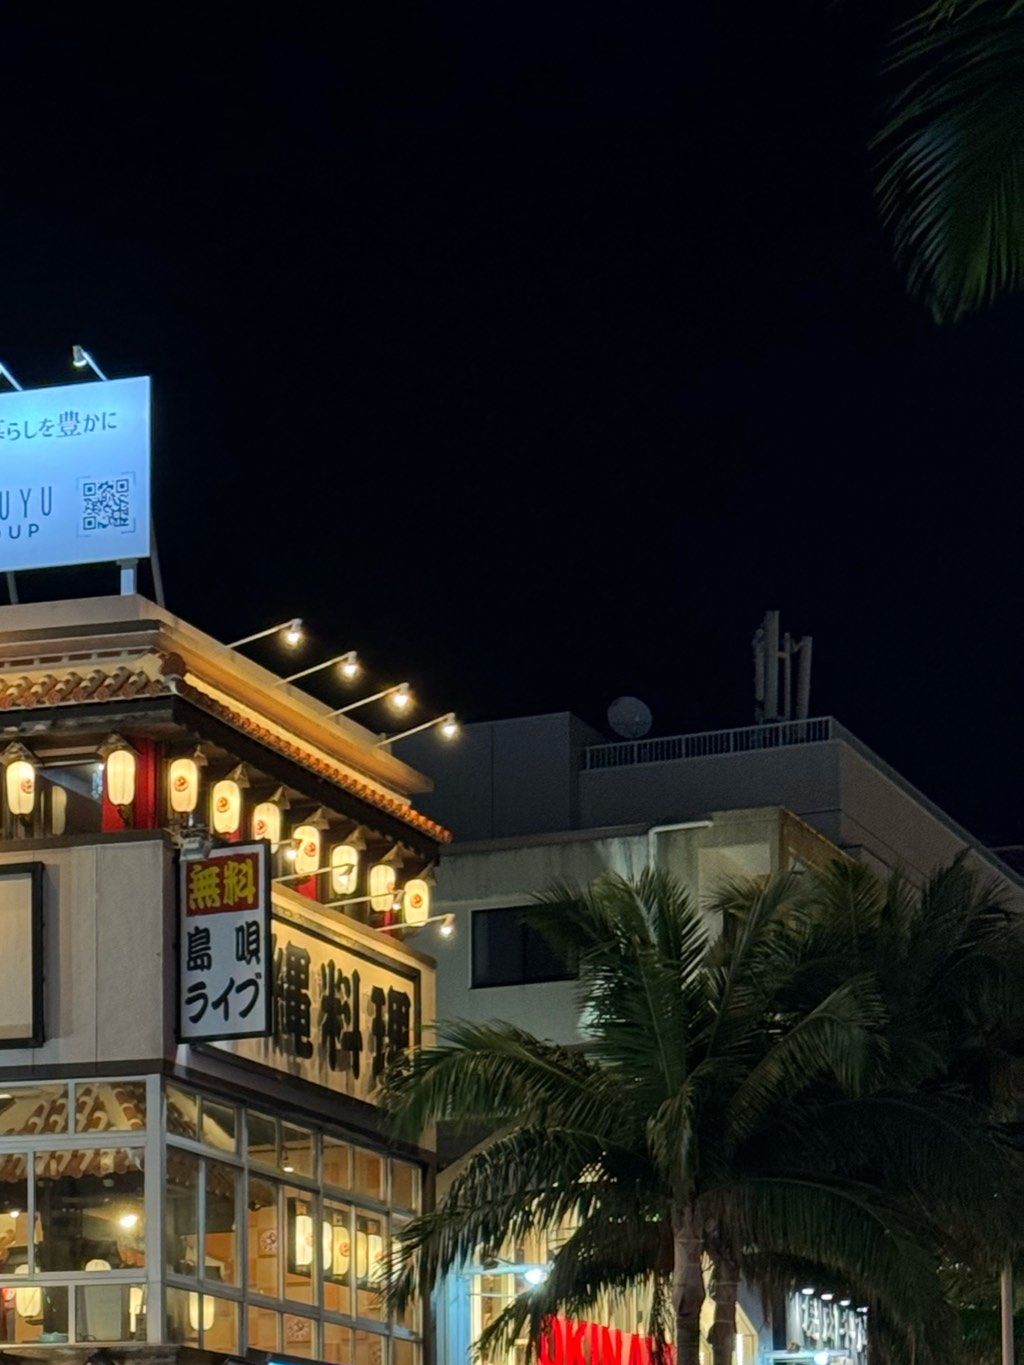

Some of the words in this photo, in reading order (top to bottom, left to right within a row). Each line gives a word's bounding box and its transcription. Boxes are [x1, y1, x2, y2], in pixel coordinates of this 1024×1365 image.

[188, 859, 256, 909] 無料
[186, 972, 263, 1024] ライブ
